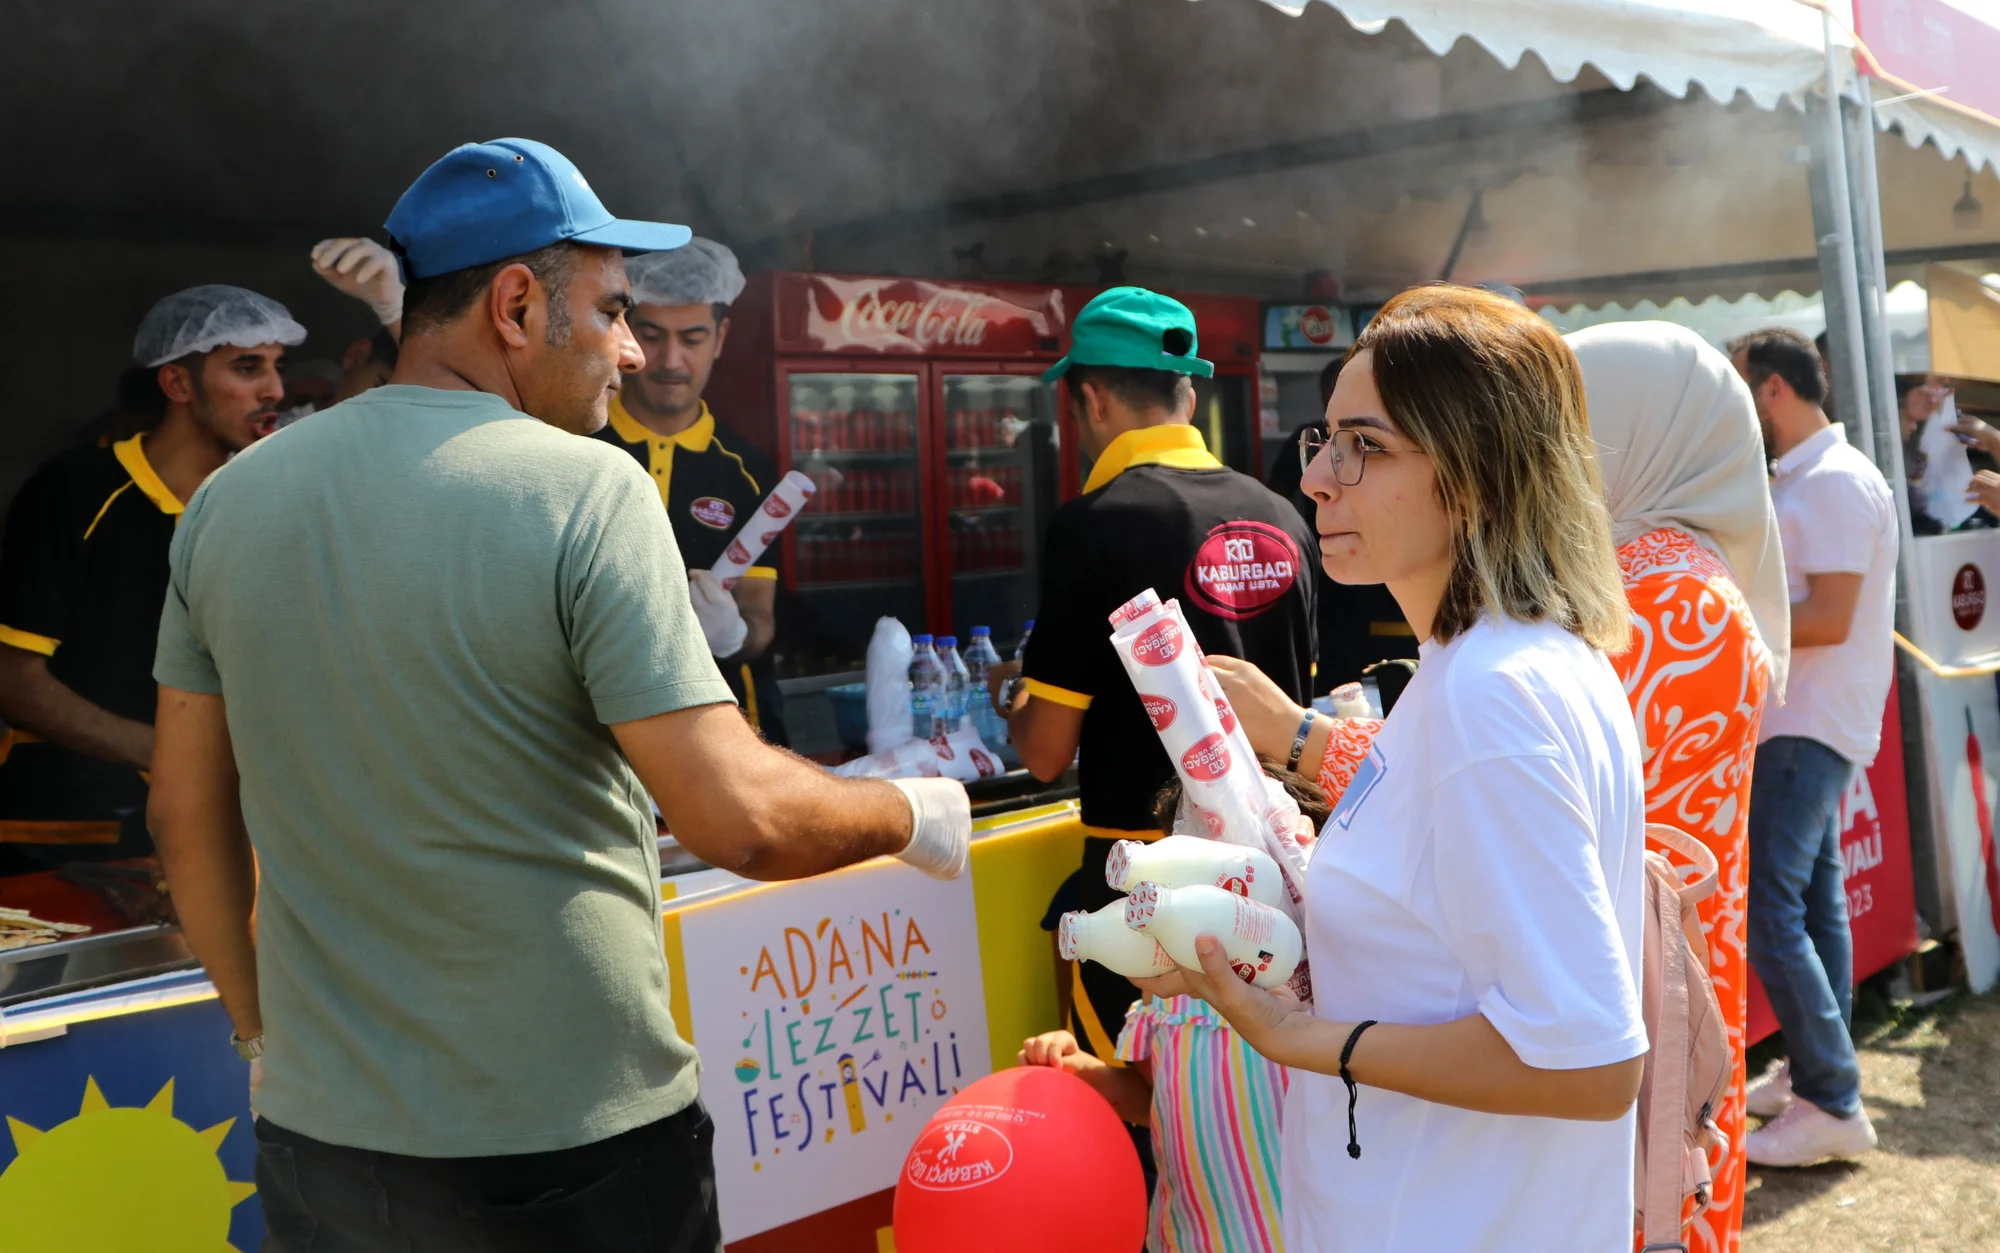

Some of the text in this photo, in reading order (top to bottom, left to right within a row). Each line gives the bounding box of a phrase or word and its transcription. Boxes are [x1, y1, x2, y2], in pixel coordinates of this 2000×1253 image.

[841, 287, 988, 347] Coca-Cola
[1198, 561, 1293, 583] KABURGACI
[1249, 580, 1280, 591] USTA
[751, 911, 931, 1000] ADANA
[764, 983, 922, 1081] LEZZET
[938, 1123, 982, 1135] STEAK
